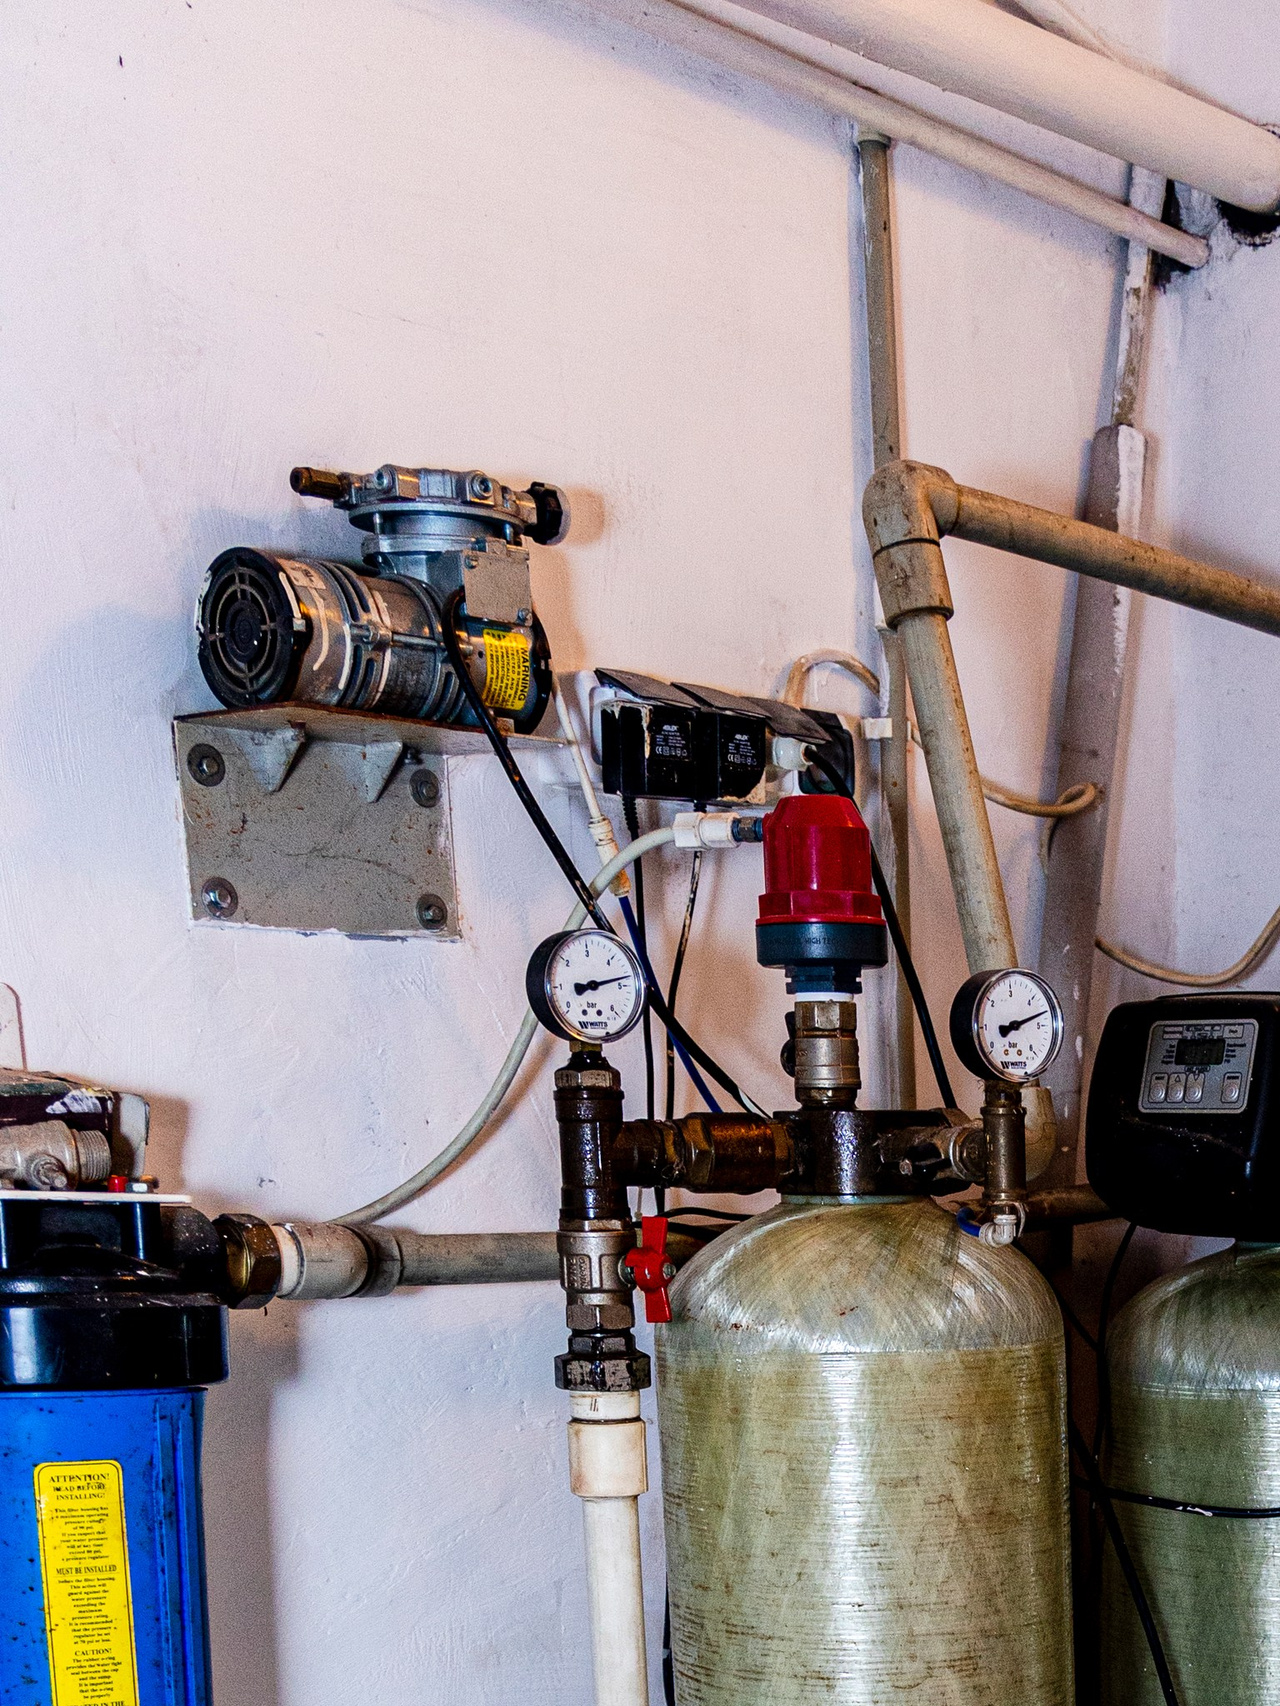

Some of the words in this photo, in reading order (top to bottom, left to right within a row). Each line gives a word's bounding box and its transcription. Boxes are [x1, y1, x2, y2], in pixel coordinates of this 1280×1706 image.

[517, 647, 530, 702] WARNING
[586, 1001, 597, 1009] bar
[1008, 1041, 1018, 1049] bar
[48, 1473, 110, 1483] ATTENTION!
[56, 1568, 73, 1576] MUST
[84, 1564, 117, 1574] INSTALLED
[74, 1648, 112, 1656] CAUTION!
